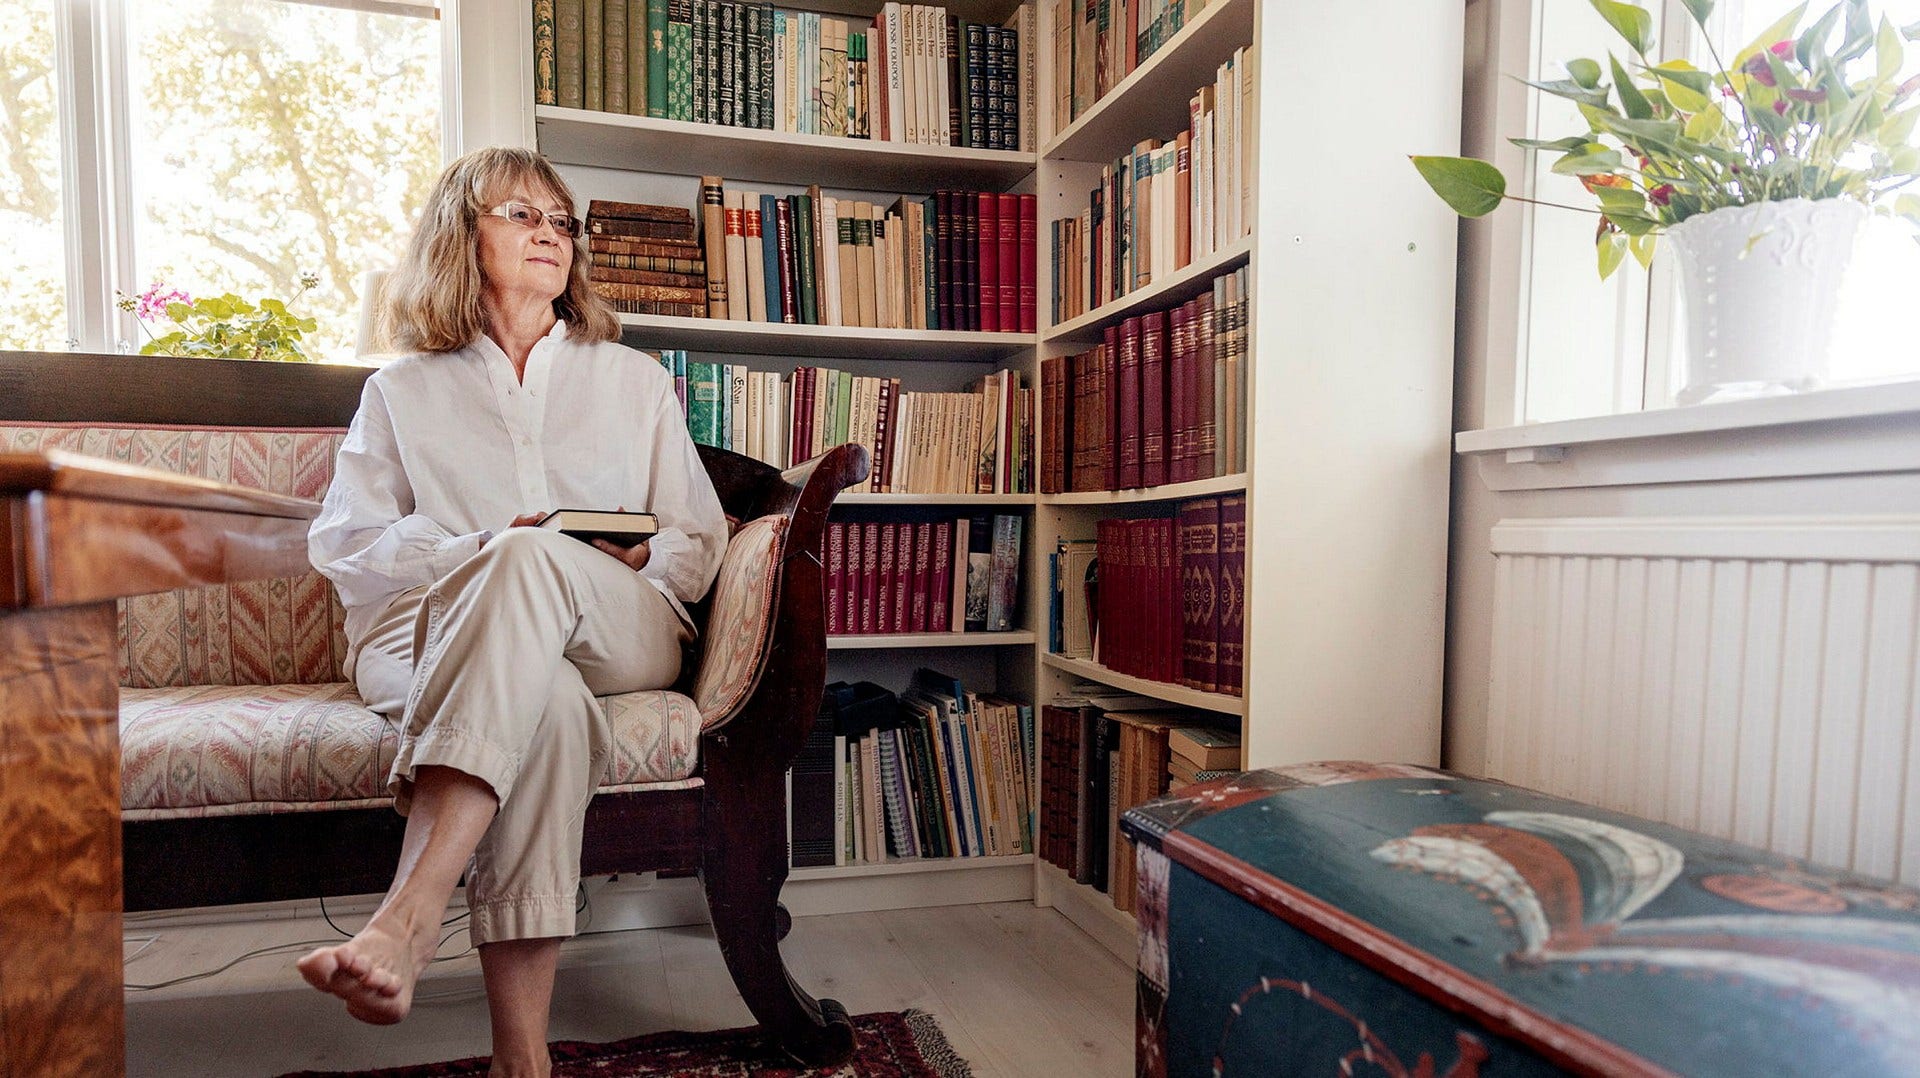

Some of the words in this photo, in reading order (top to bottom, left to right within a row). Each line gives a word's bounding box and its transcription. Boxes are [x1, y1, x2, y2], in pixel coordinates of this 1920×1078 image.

[916, 38, 924, 56] Flora
[891, 46, 899, 89] FOLKPOESI
[908, 128, 914, 136] 2
[875, 782, 881, 794] OM
